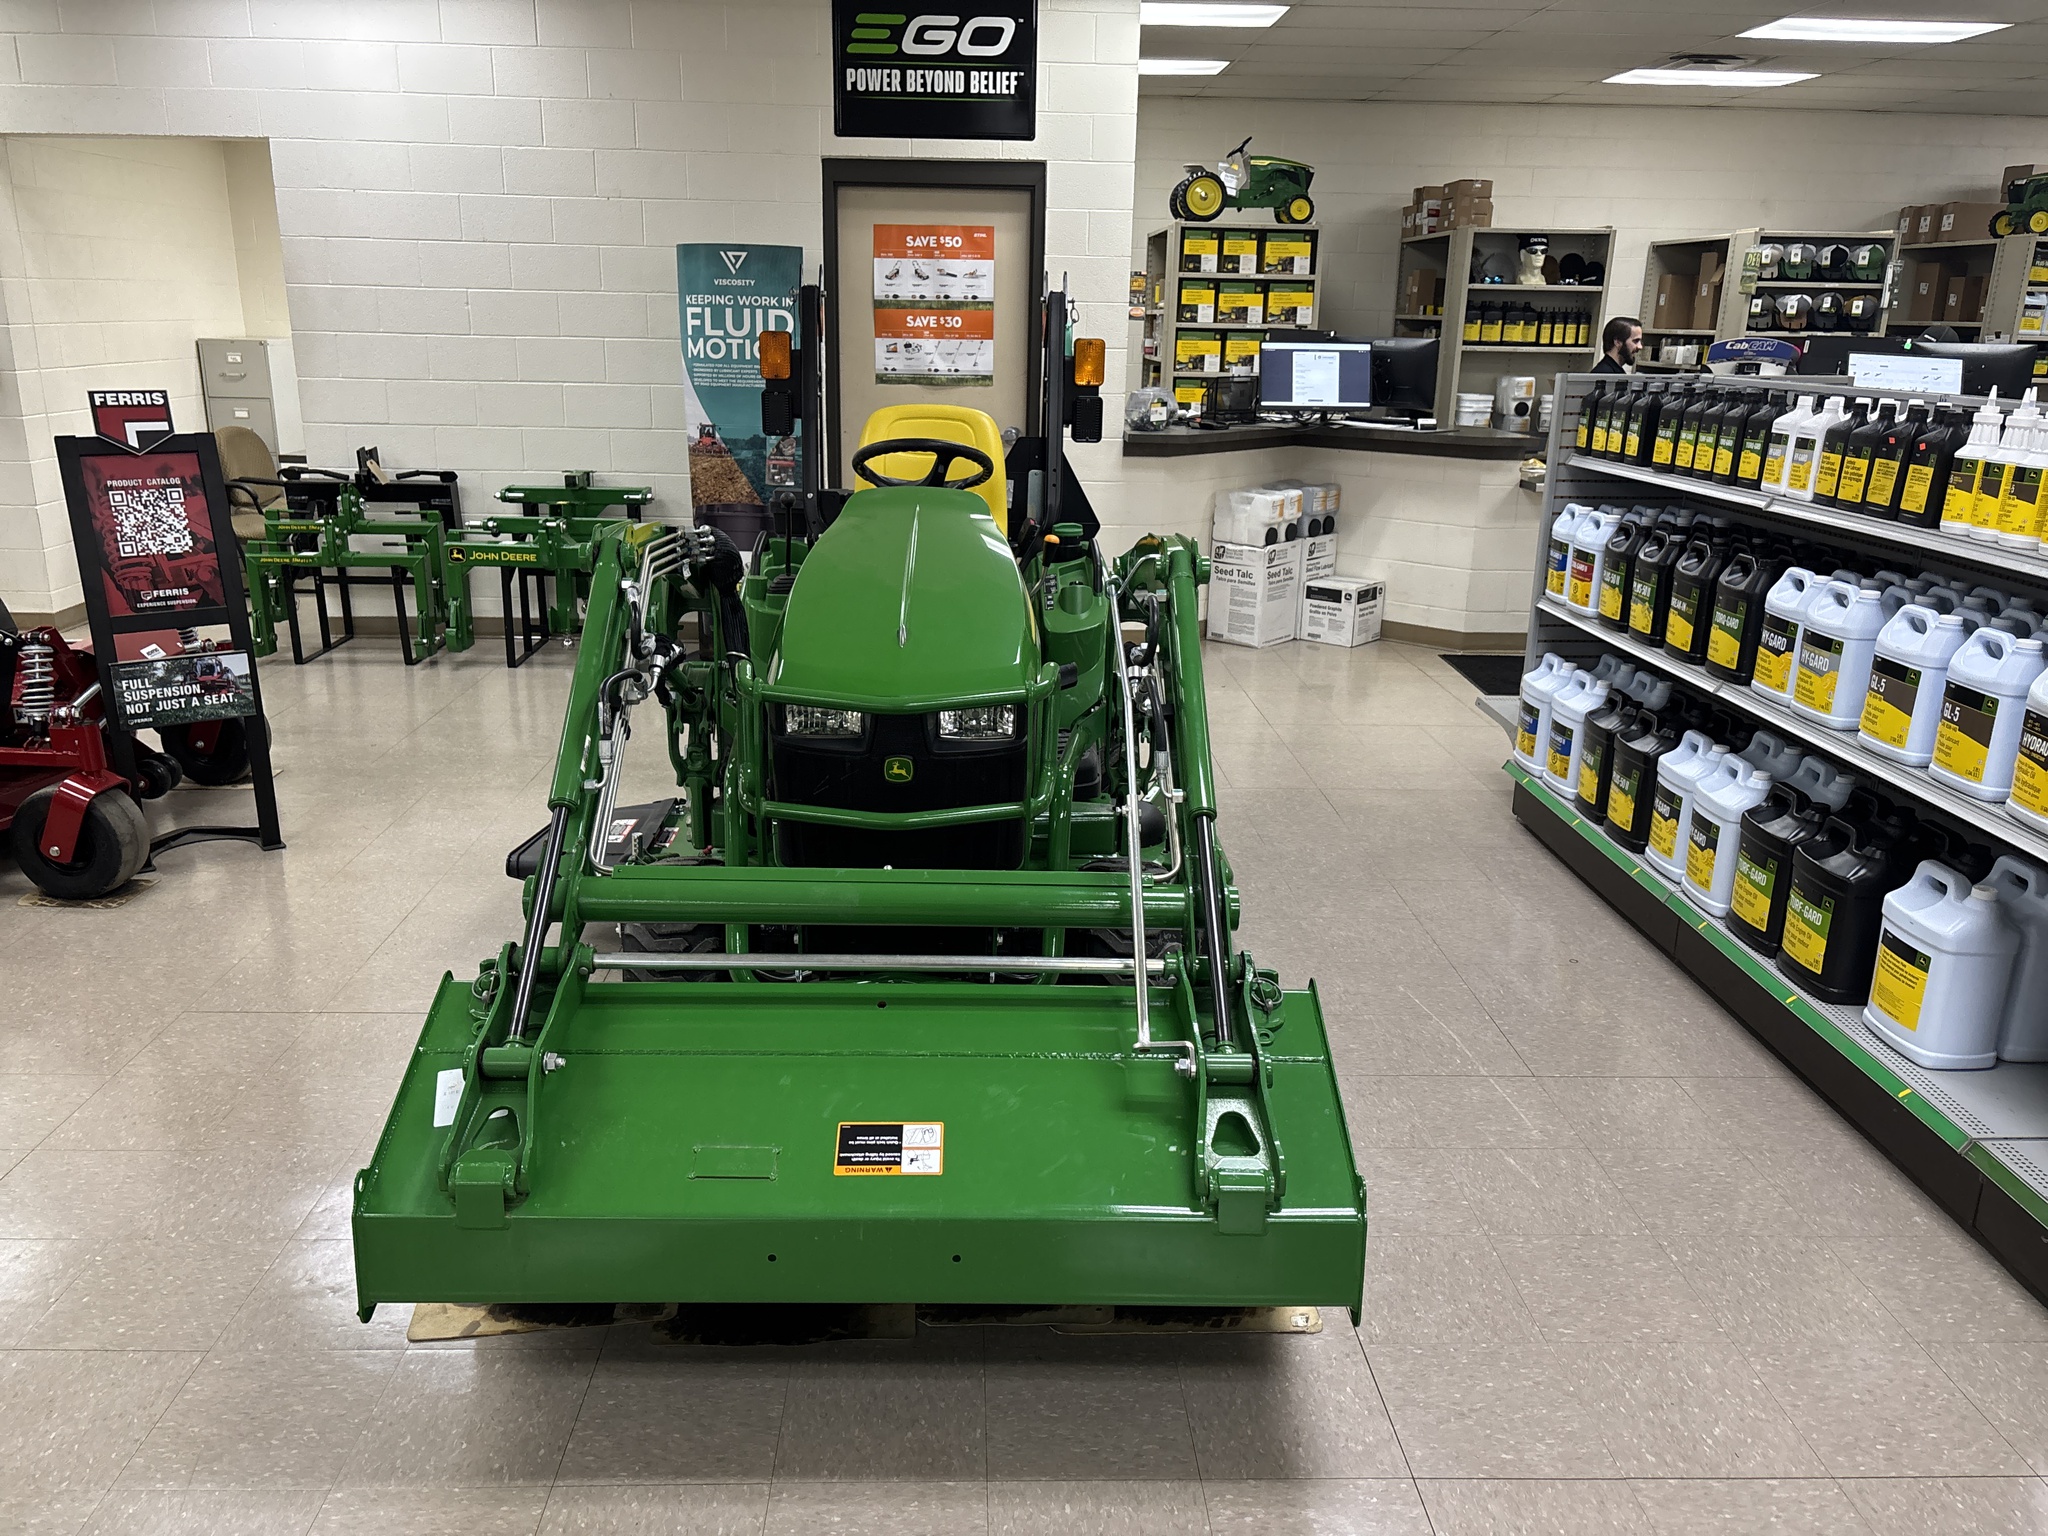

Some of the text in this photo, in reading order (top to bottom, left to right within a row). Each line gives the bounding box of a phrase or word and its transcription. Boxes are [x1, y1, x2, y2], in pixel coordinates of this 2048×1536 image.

[846, 13, 1016, 56] EGO
[846, 68, 1018, 95] POWER BEYOND BELIEF
[906, 235, 962, 248] SAVE $50
[713, 278, 756, 287] VISCOSITY
[685, 294, 795, 307] KEEPING WORK IN
[686, 307, 795, 338] FLUID
[906, 315, 962, 329] SAVE $30
[1725, 340, 1778, 351] CabCAM
[93, 392, 165, 406] FERRIS
[107, 477, 181, 487] PRODUCT CATALOG
[469, 550, 537, 562] JOHN DEERE
[1214, 565, 1254, 579] Seed Talc
[1267, 566, 1293, 580] Seed Talc
[153, 588, 189, 598] FERRIS
[1633, 581, 1648, 597] PLUS-50
[1761, 629, 1787, 651] HY-GARD
[1800, 648, 1829, 672] HY-GARD
[122, 678, 152, 690] FULL
[1870, 674, 1887, 693] GL-5
[124, 684, 205, 703] SUSPENSION.
[126, 692, 238, 715] NOT JUST A SEAT.
[1943, 702, 1961, 722] GL-5
[134, 717, 153, 725] FERRIS
[1738, 858, 1767, 886] TURF-GARD
[1789, 894, 1823, 926] TURF-GARD
